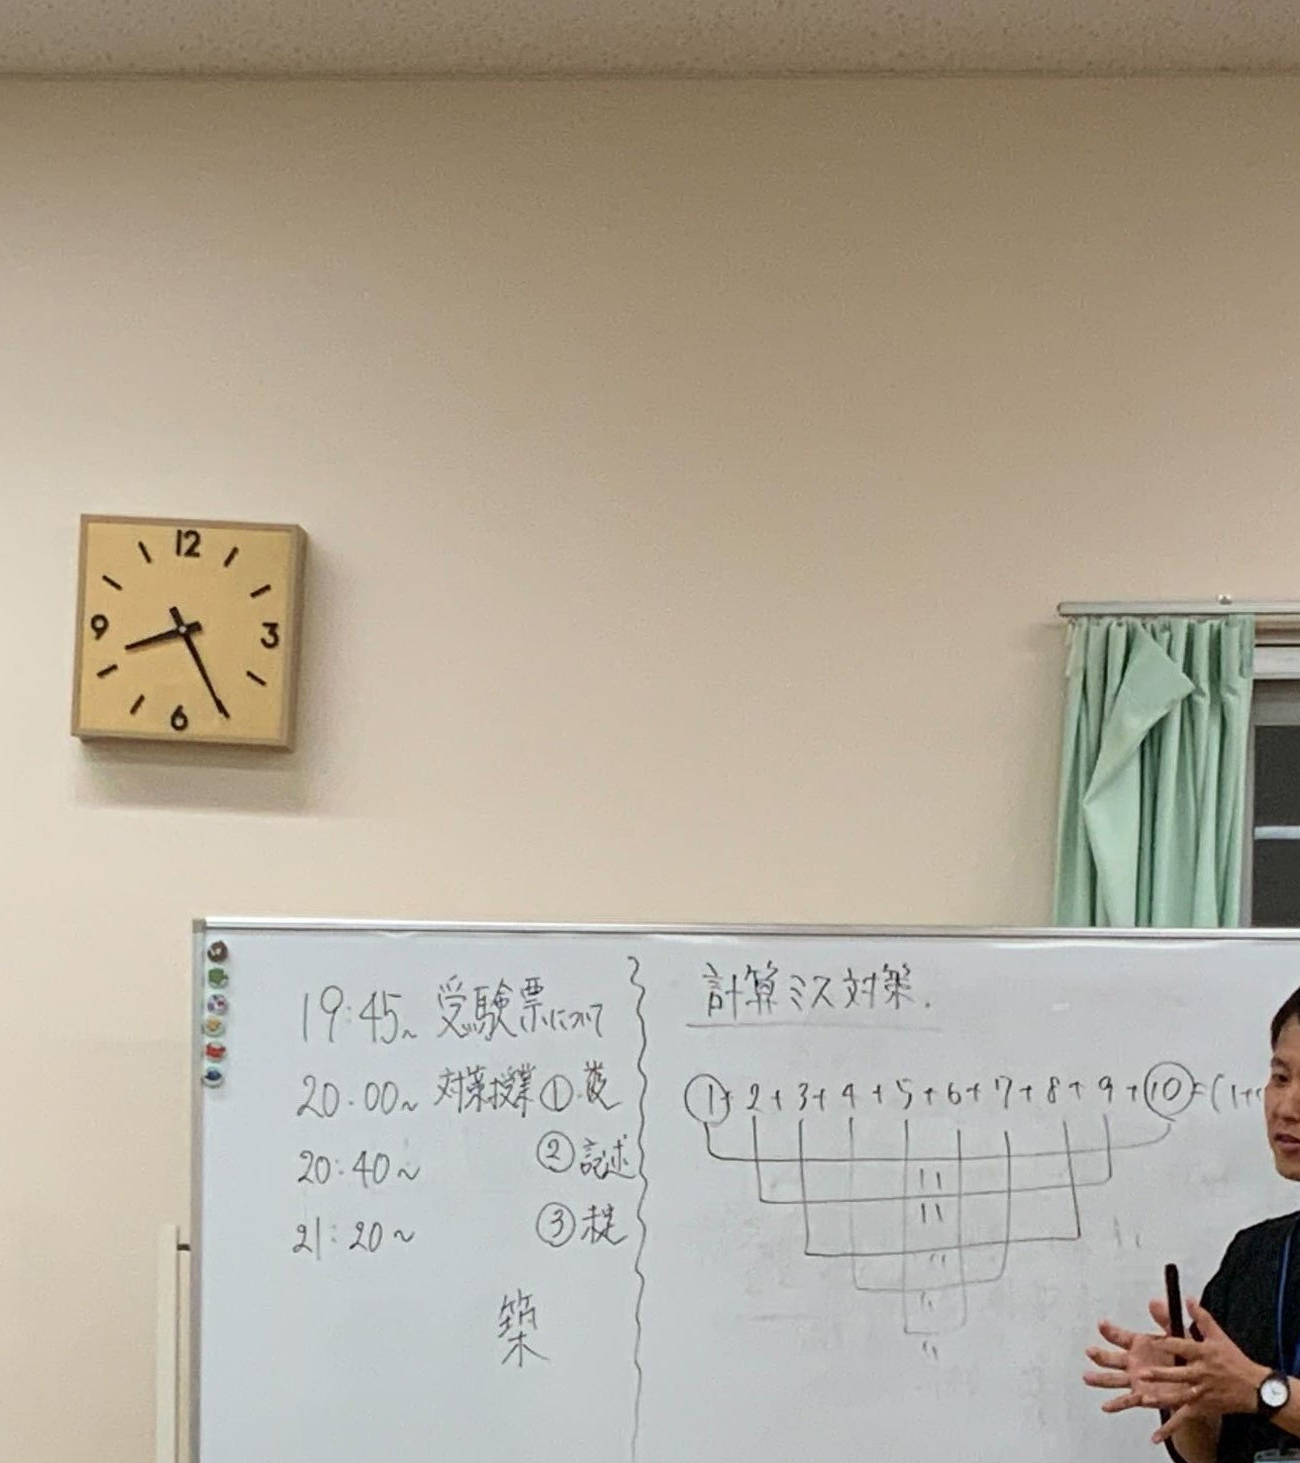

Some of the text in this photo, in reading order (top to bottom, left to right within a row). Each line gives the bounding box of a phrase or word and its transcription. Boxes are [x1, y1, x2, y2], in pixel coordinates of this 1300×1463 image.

[176, 529, 201, 557] 12
[90, 614, 109, 641] 9
[261, 622, 280, 648] 3
[170, 705, 189, 731] 6
